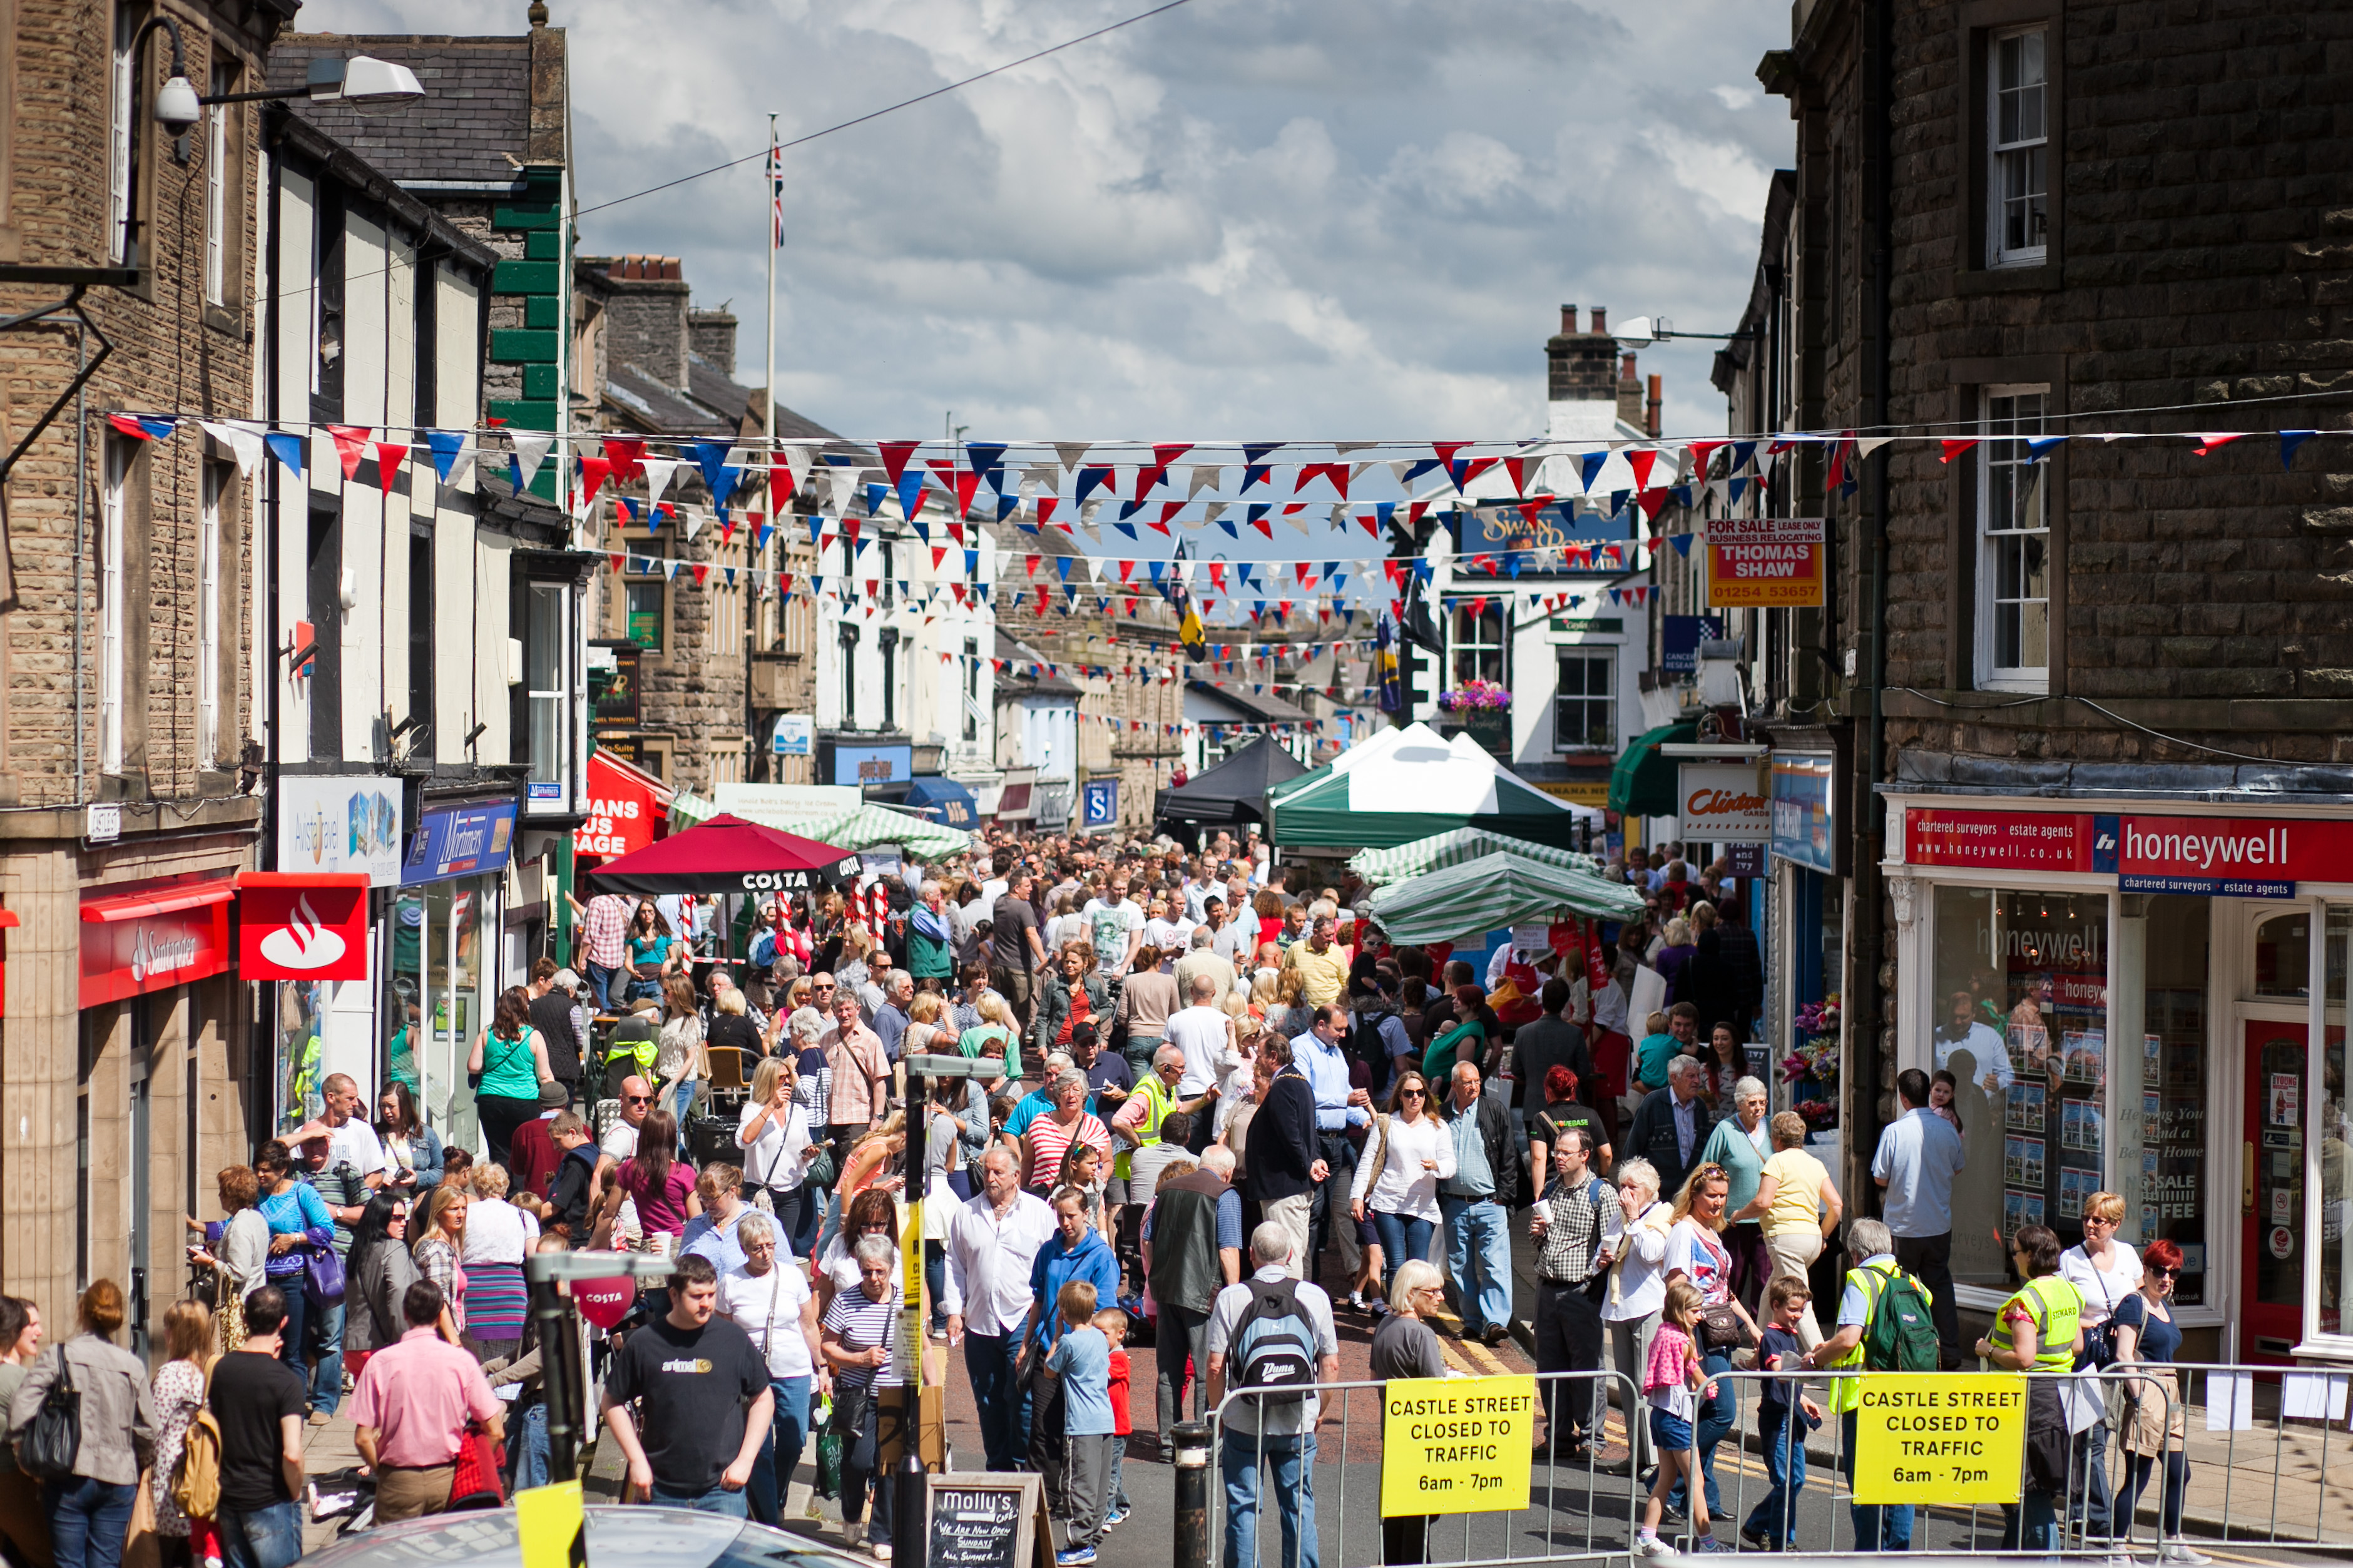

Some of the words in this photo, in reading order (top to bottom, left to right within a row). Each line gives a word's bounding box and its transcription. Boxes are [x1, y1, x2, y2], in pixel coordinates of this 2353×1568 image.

[1707, 521, 1735, 534] FOR
[1738, 520, 1775, 533] SALE
[1778, 522, 1801, 531] LEASE
[1803, 521, 1821, 530] ONLY
[1709, 534, 1758, 542] BUSINESS
[1760, 533, 1822, 542] RELOCATING
[1722, 545, 1809, 561] THOMAS
[1735, 562, 1795, 578] SHAW
[1714, 587, 1762, 598] 01254
[1769, 586, 1817, 597] 53657
[531, 785, 559, 797] Mortimers
[780, 798, 800, 808] Dairy
[1688, 788, 1767, 815] Clinton
[439, 810, 484, 863] Mortimers
[1917, 819, 1954, 833] chartered
[1956, 823, 1997, 837] surveyors
[2009, 824, 2038, 837] estate
[2041, 826, 2073, 840] agents
[1917, 842, 2073, 860] www.honeywell.co.uk
[2126, 823, 2287, 870] honeywell
[839, 855, 861, 877] COSTA
[742, 872, 809, 890] COSTA
[2125, 877, 2166, 889] chartered
[2169, 880, 2211, 892] surveyors
[2224, 883, 2253, 893] estate
[2257, 884, 2288, 895] agents
[148, 924, 195, 976] Santander
[1977, 919, 2098, 966] honeywell
[1748, 1051, 1764, 1059] Ivy
[2276, 1076, 2297, 1086] YOUNG
[2178, 1108, 2203, 1120] You
[2163, 1146, 2203, 1158] Home
[2156, 1175, 2195, 1188] SALE
[2161, 1203, 2195, 1219] FEE
[586, 1292, 623, 1304] COSTA
[2052, 1307, 2076, 1320] STEWARD
[662, 1358, 697, 1373] animal
[1262, 1362, 1296, 1377] Puma
[1391, 1399, 1457, 1416] CASTLE
[1464, 1396, 1531, 1414] STREET
[1863, 1391, 1939, 1407] CASTLE
[1947, 1391, 2021, 1407] STREET
[1411, 1422, 1482, 1440] CLOSED
[1489, 1420, 1510, 1436] TO
[1886, 1416, 1968, 1432] CLOSED
[1974, 1416, 1999, 1432] TO
[1425, 1445, 1497, 1462] TRAFFIC
[1901, 1441, 1983, 1456] TRAFFIC
[1419, 1475, 1452, 1490] 6am
[1471, 1474, 1503, 1491] 7pm
[1893, 1467, 1931, 1482] 6am
[1952, 1467, 1988, 1484] 7pm
